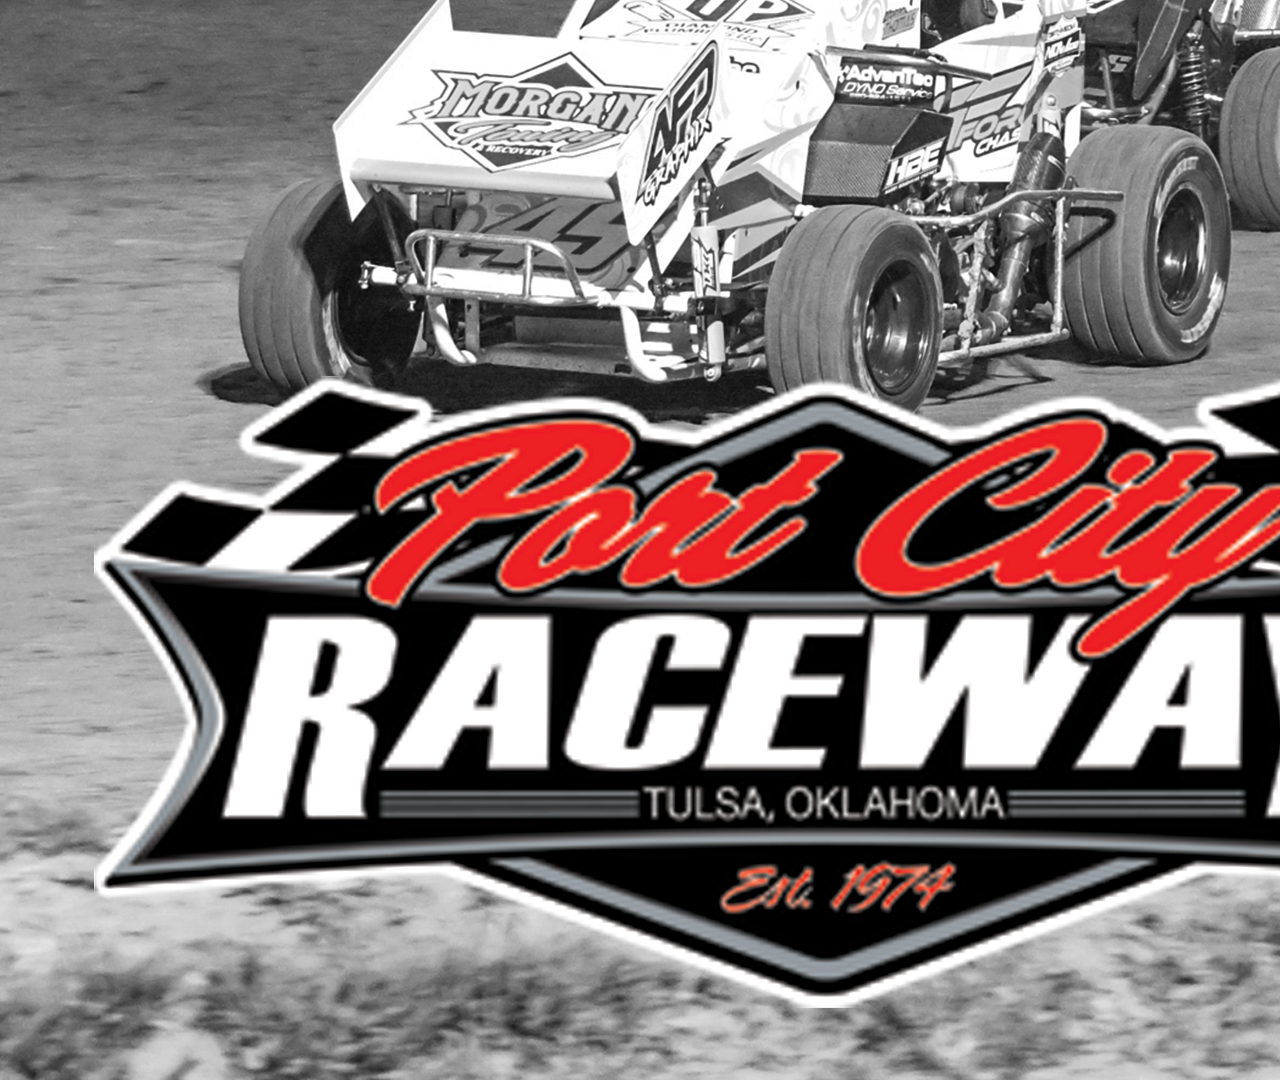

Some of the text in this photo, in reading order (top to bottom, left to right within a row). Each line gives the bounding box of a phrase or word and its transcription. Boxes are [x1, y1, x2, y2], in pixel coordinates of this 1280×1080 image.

[843, 81, 885, 94] DYNO
[432, 78, 650, 134] MORGAN
[485, 146, 553, 156] RECOVERY
